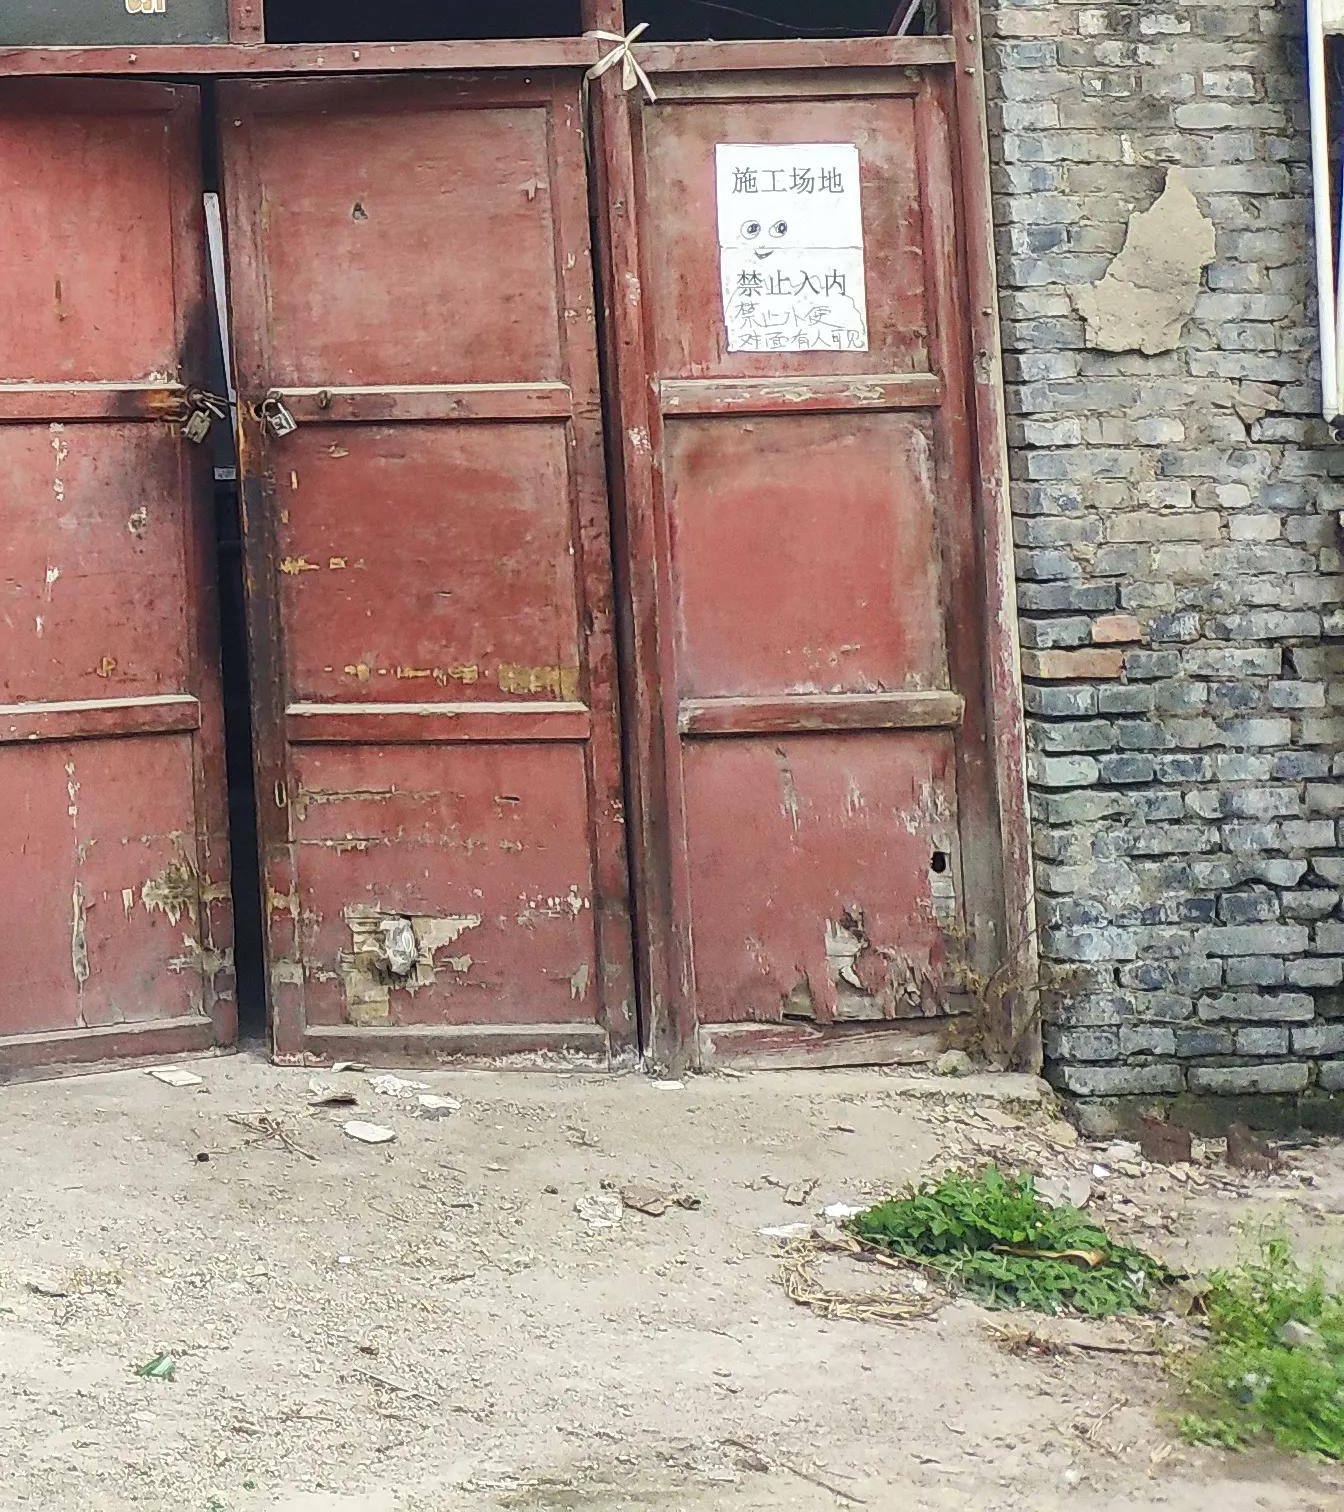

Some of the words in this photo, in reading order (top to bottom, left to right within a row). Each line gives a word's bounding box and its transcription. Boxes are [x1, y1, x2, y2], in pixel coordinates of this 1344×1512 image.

[731, 166, 845, 194] 施工场地
[736, 268, 847, 298] 禁止入内
